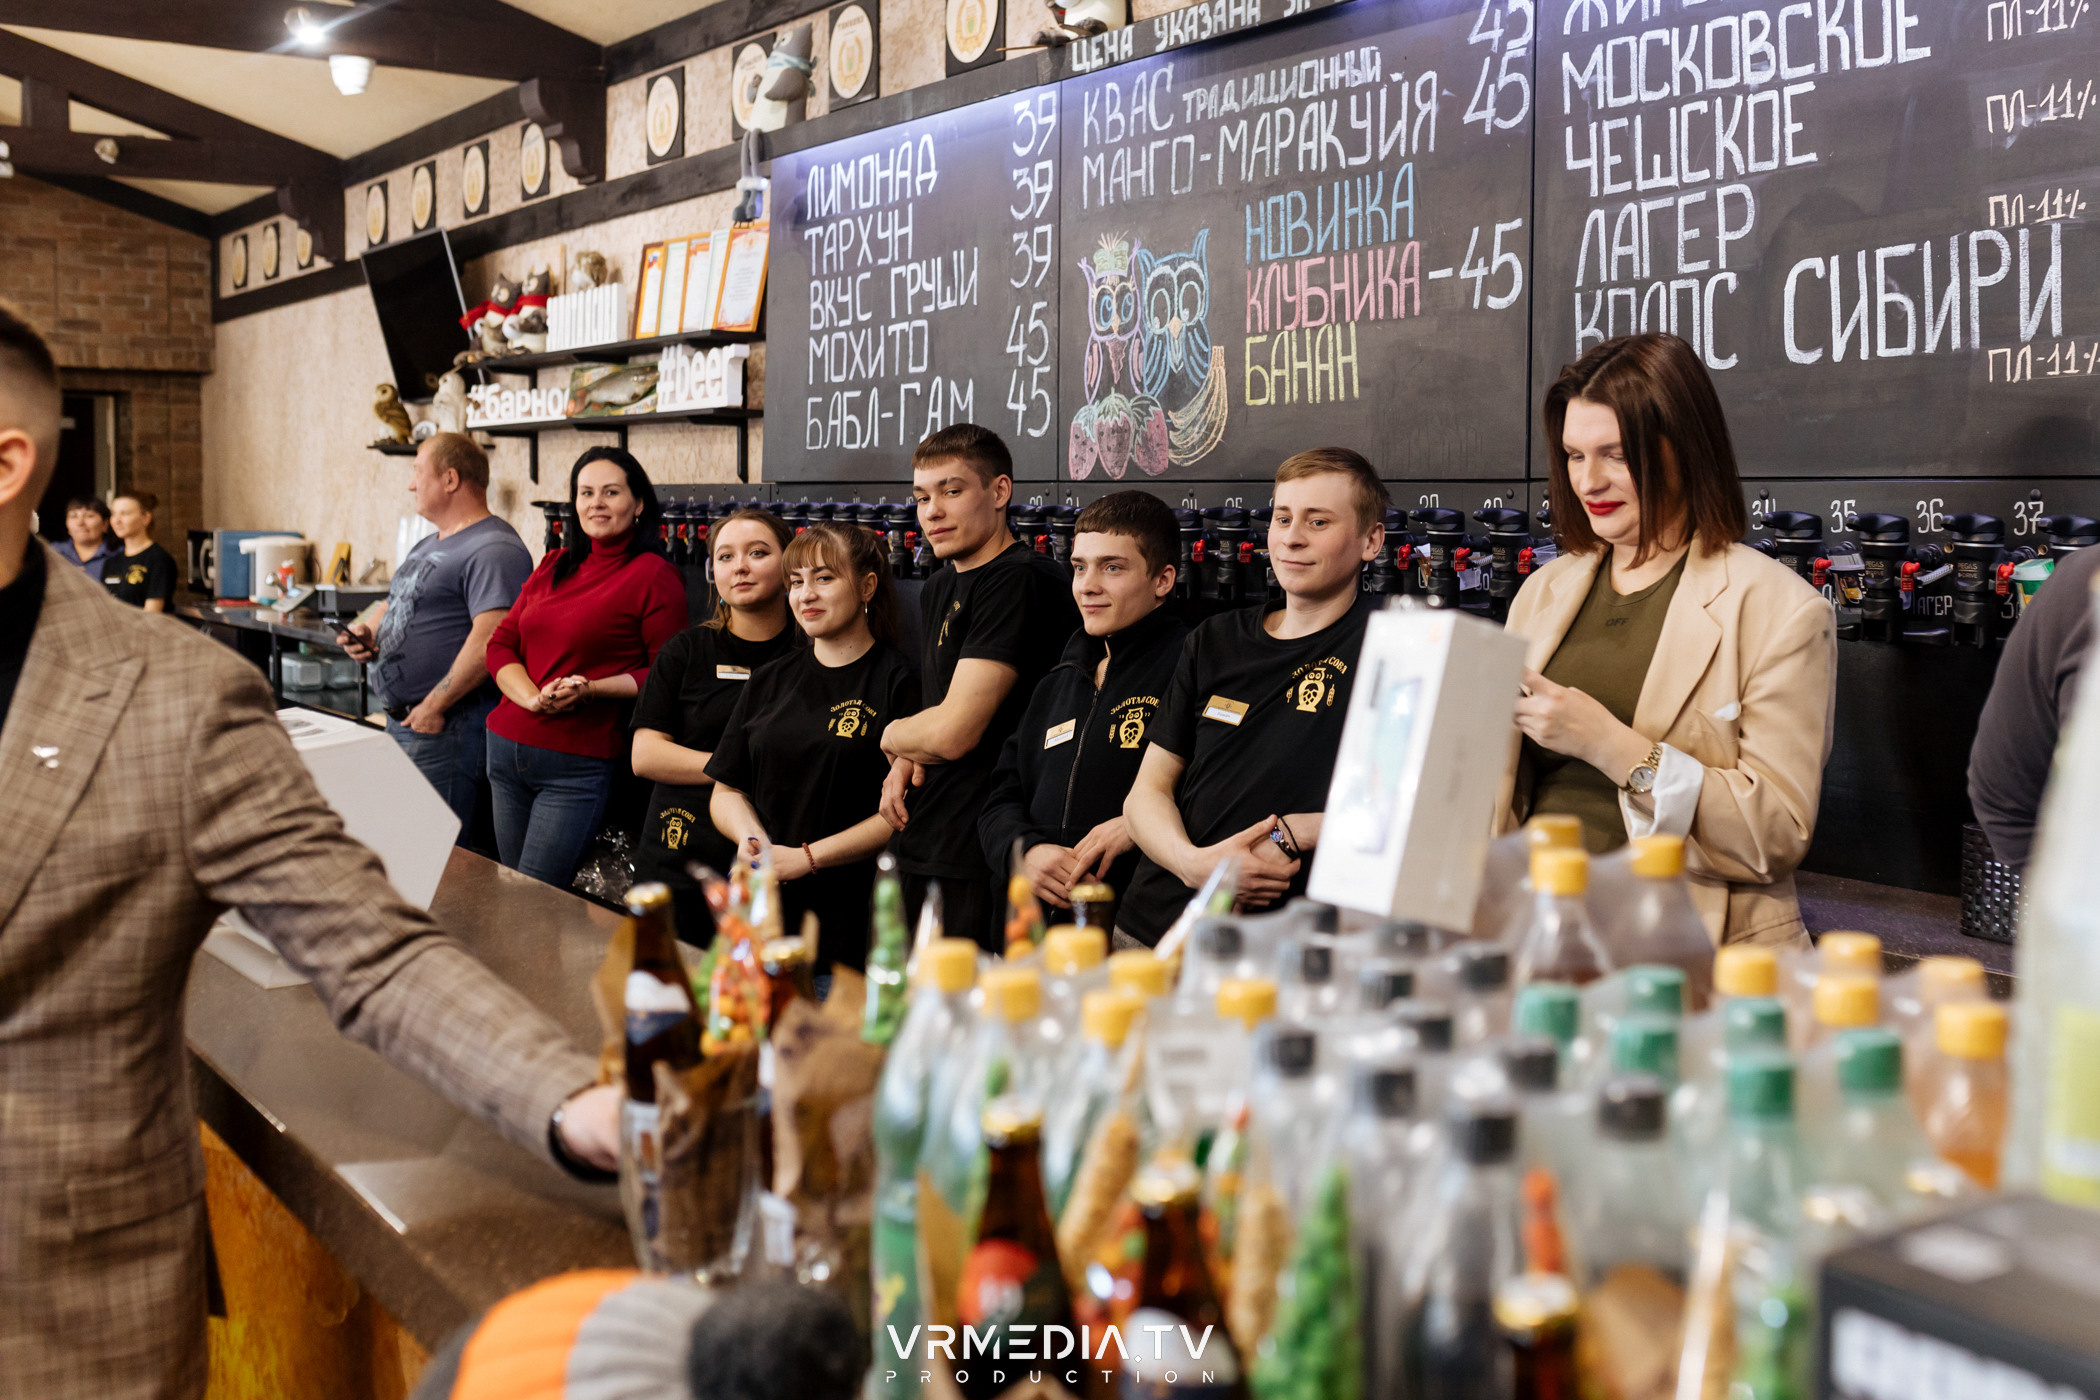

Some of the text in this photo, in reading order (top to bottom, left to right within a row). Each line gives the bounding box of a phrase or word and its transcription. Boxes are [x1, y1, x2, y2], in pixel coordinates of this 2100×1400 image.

[1071, 25, 1135, 73] ЦЕНА
[1154, 0, 1262, 52] УКАЗАНА
[1083, 62, 1175, 148] КВАС
[1182, 46, 1382, 124] ТРАДИЦИОННЫЙ
[1467, 0, 1533, 53] 45
[1562, 0, 1931, 115] МОСКОВСКОЕ
[806, 90, 1057, 221] ЛИМОНАД 39
[1082, 47, 1530, 210] МАНГО-МАРАКУЙЯ 45
[1565, 81, 1818, 197] ЧЕШСКОЕ
[804, 160, 1053, 276] ТАРХУН 39
[1245, 162, 1414, 265] НОВИНКА
[1575, 183, 1755, 287] ЛАГЕР
[810, 271, 872, 331] ВКУС
[890, 246, 978, 318] ГРУШИ
[1010, 224, 1052, 288] 39
[1246, 240, 1420, 333] КЛУБНИКА
[1783, 222, 2063, 364] СИБИРИ
[657, 344, 750, 411] #beer
[809, 301, 1050, 385] МОХИТО 45
[1245, 320, 1360, 406] БАНАН
[806, 366, 1051, 450] БАБЛ-ГАМ 45
[1916, 498, 1945, 534] 36
[2013, 500, 2044, 536] 37
[1145, 695, 1160, 709] СОВ
[1328, 656, 1348, 675] СОВА
